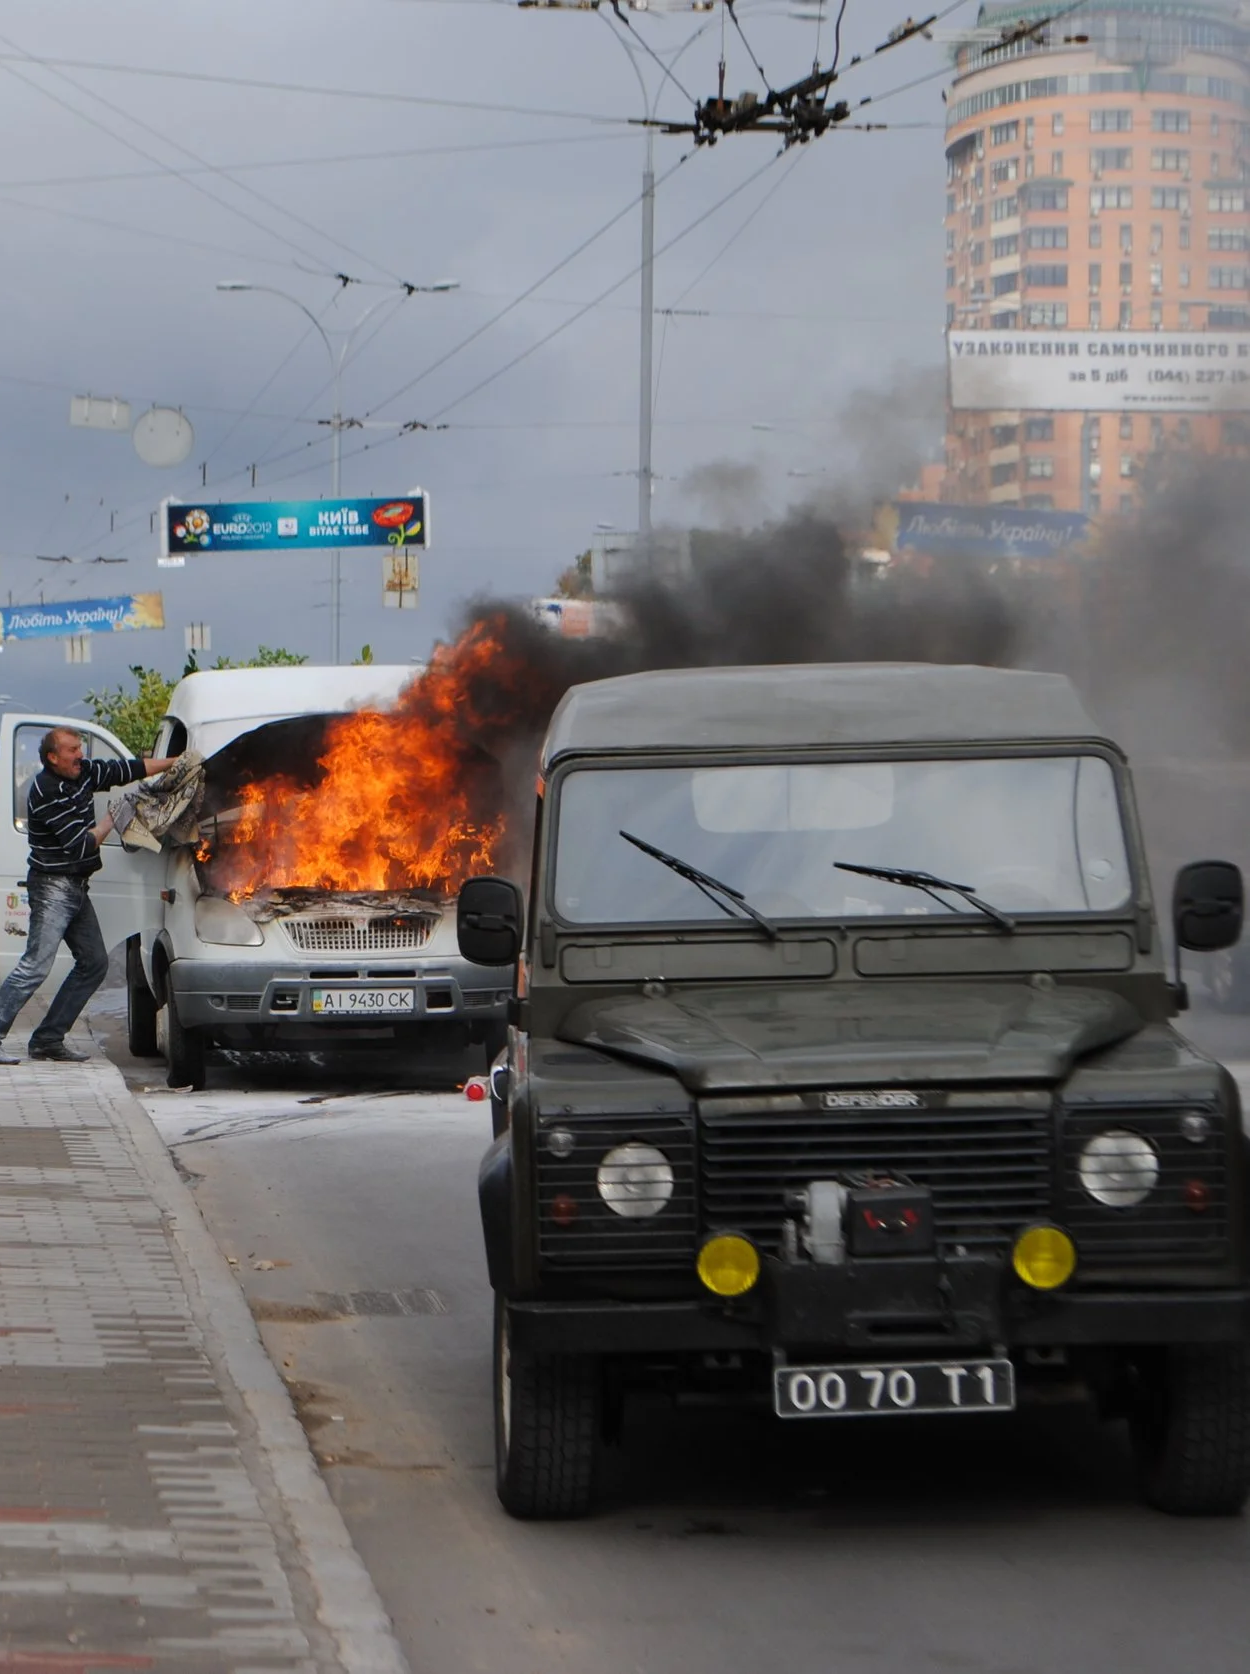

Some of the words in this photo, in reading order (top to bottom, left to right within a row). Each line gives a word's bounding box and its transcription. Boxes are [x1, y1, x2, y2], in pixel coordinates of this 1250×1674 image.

[318, 507, 359, 525] КИЇВ
[309, 526, 340, 536] ВІТАЄ
[342, 524, 369, 535] ТЕБЕ
[987, 519, 1073, 546] Україну!
[8, 612, 63, 630] Любіть
[65, 605, 124, 627] Україну!
[324, 993, 342, 1008] AI
[349, 993, 384, 1008] 9430
[388, 992, 410, 1008] CK
[826, 1095, 920, 1107] DEFENDER
[859, 1368, 916, 1408] 70
[941, 1365, 996, 1405] T1
